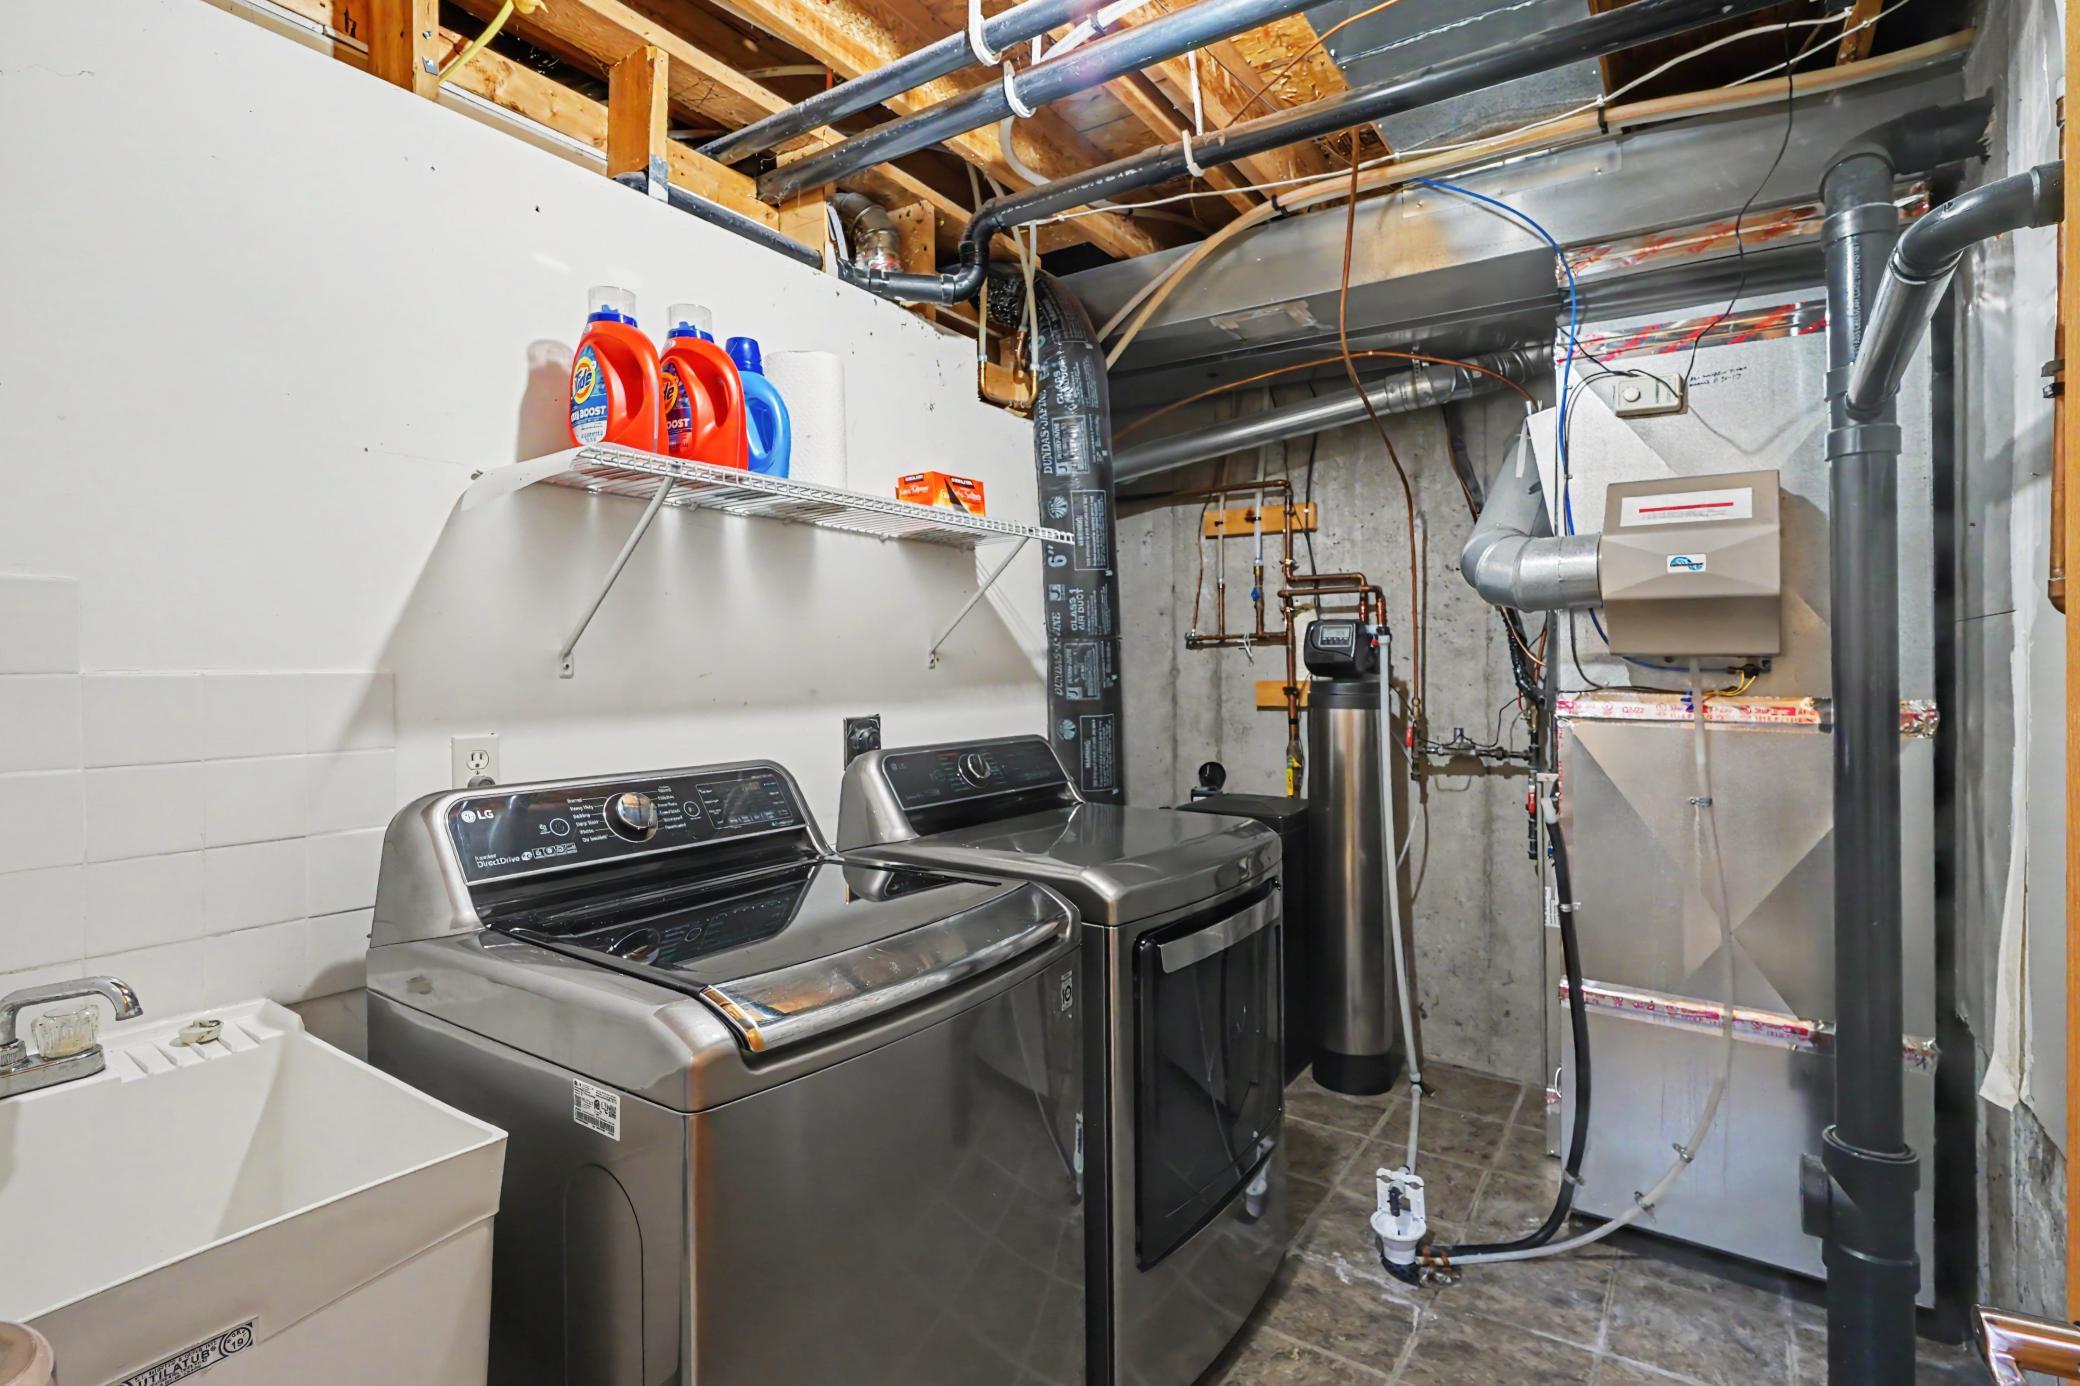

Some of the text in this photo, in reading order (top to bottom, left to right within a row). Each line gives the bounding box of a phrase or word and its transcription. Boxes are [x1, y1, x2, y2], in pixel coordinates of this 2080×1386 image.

[575, 368, 593, 391] Tide
[579, 405, 607, 418] BOOST
[666, 418, 689, 430] OOST
[1068, 596, 1078, 631] CLASS
[1075, 587, 1085, 631] AIR DUCT
[477, 809, 495, 820] LG
[231, 1338, 244, 1350] 19
